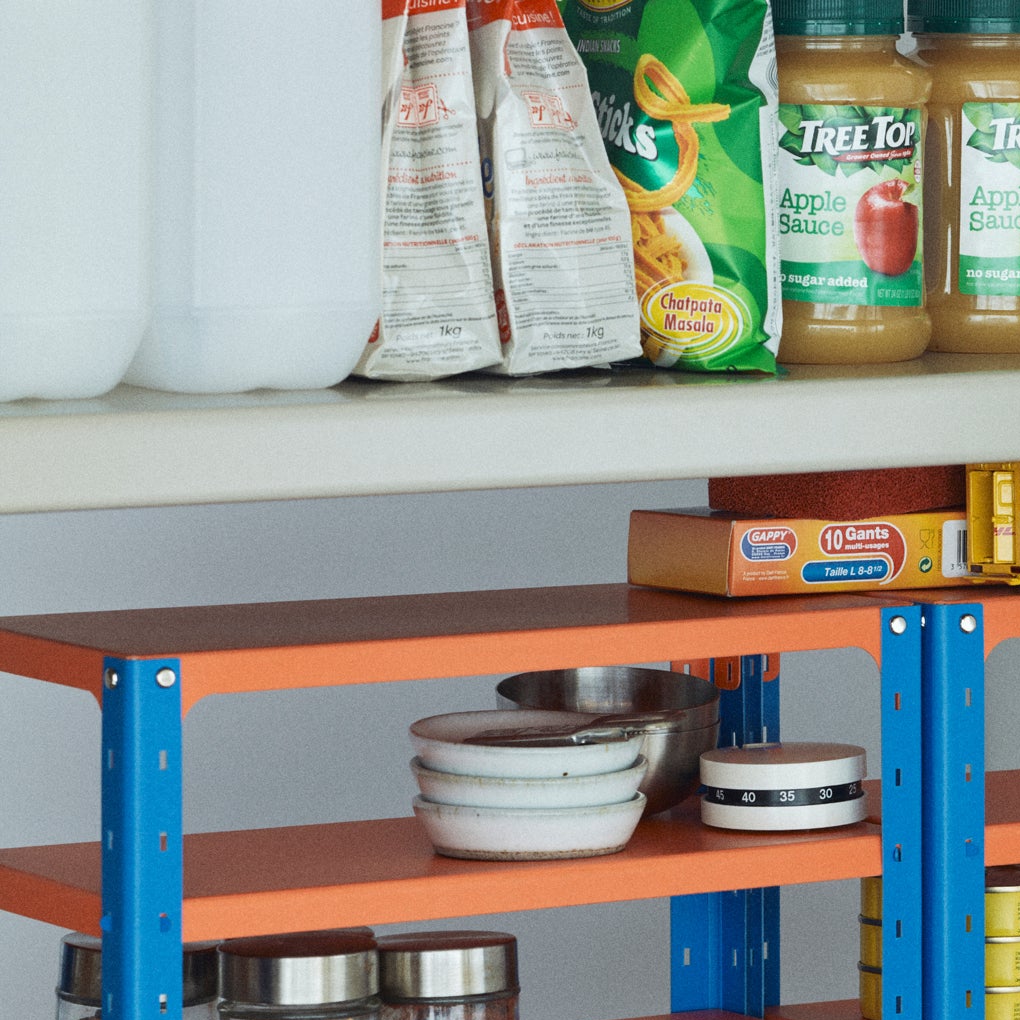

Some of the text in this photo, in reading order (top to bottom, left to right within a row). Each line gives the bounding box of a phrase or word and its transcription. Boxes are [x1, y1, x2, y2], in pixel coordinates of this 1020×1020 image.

[799, 115, 916, 156] TREE TOP
[779, 187, 847, 215] Apple
[779, 213, 845, 237] Sauce
[966, 268, 983, 278] no
[788, 274, 868, 289] sugar added
[660, 292, 722, 317] Chatpata
[440, 324, 462, 337] 1kg
[664, 313, 714, 333] Masala
[586, 325, 605, 340] 1kg
[752, 530, 788, 542] GAPPY
[825, 526, 890, 551] 10 Gants
[844, 541, 890, 551] multi-usages
[824, 566, 849, 578] Taille
[850, 566, 857, 576] L
[715, 789, 725, 801] 45
[741, 791, 756, 803] 40
[779, 790, 796, 802] 35
[819, 787, 833, 799] 30
